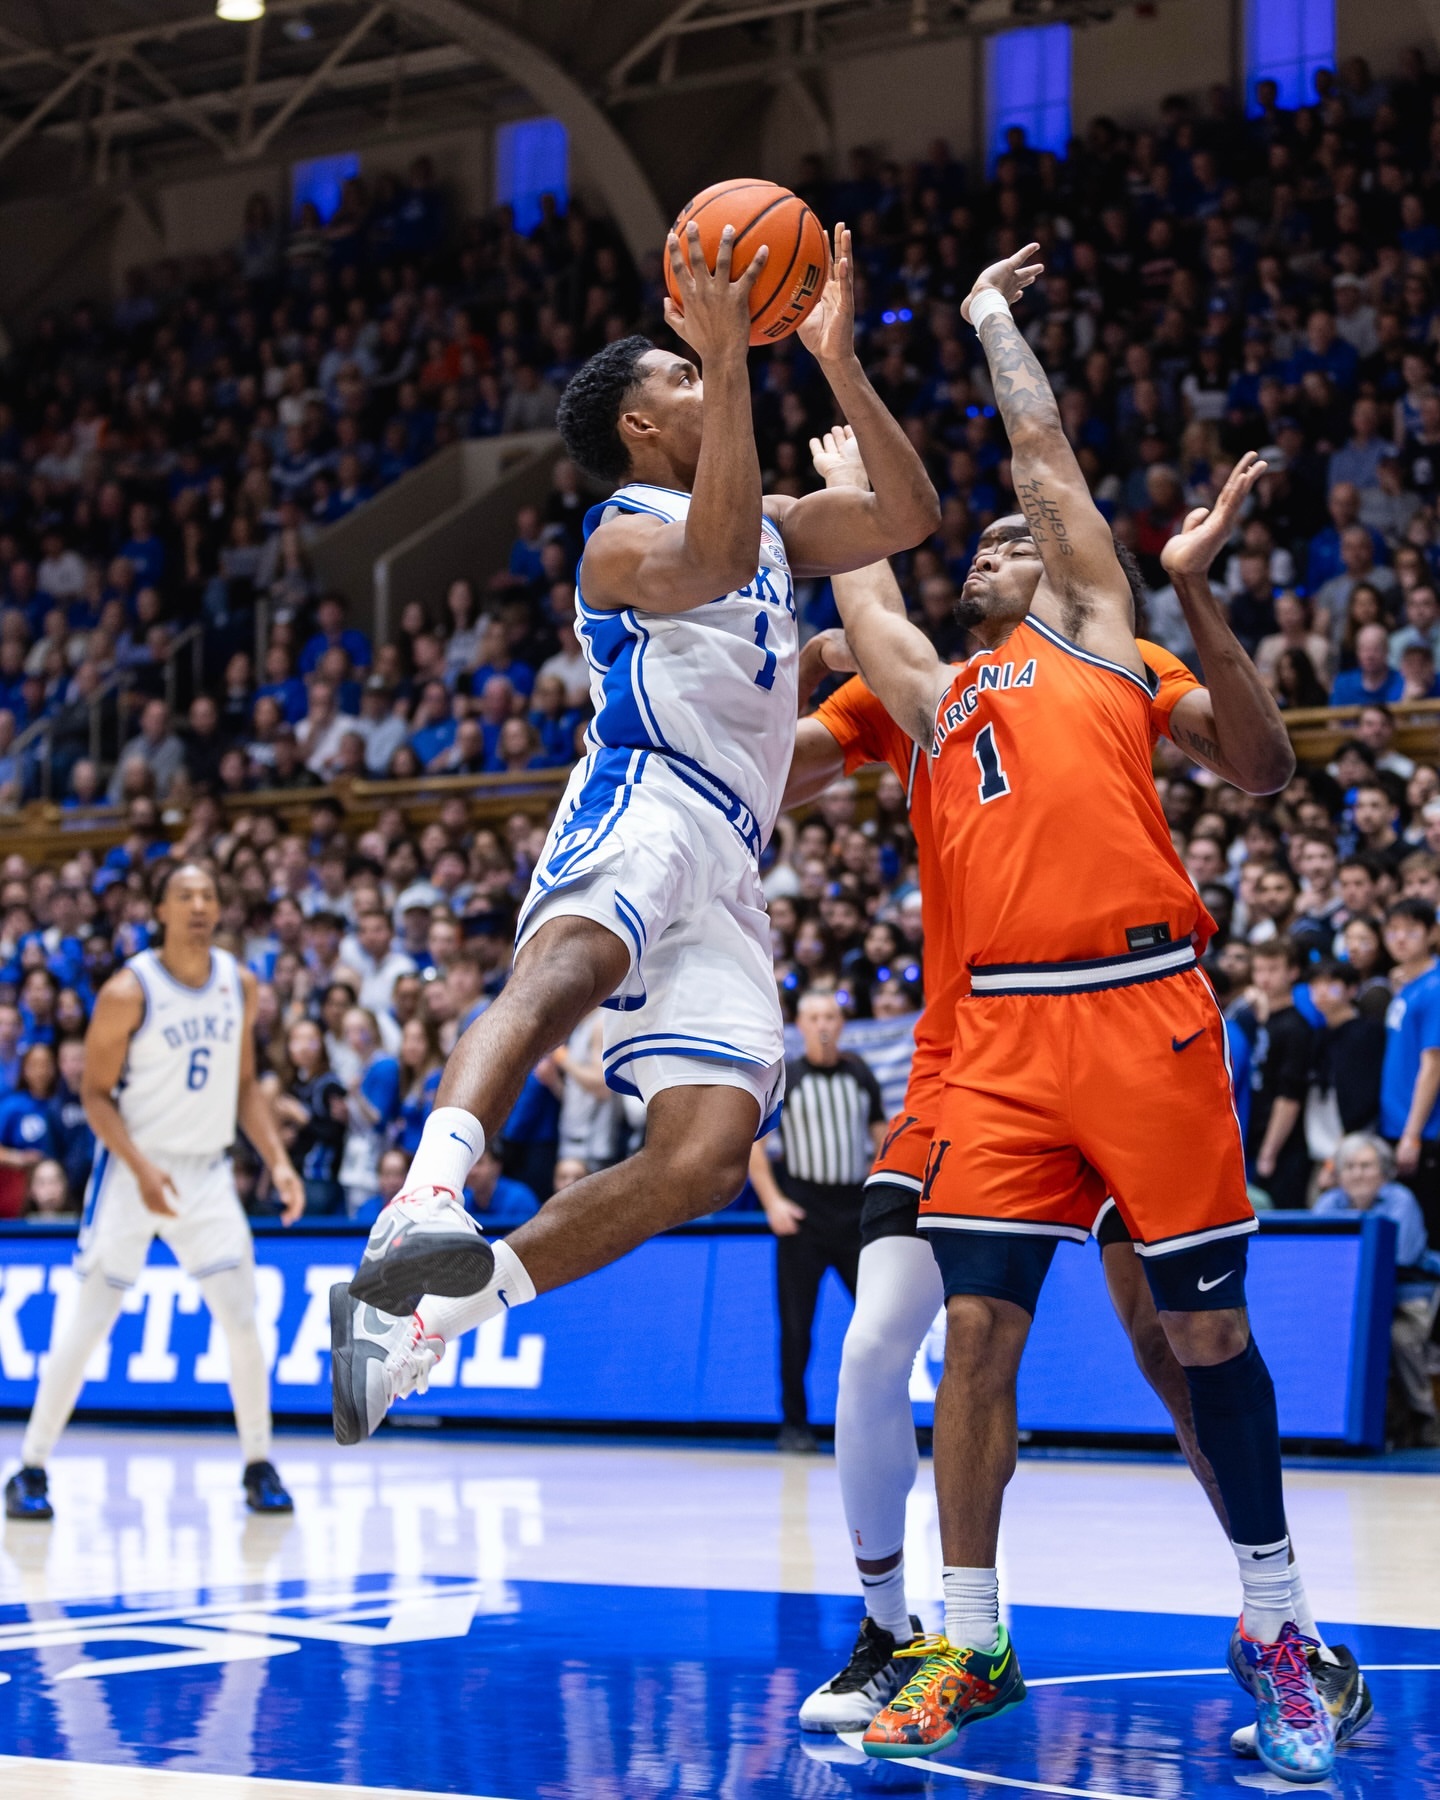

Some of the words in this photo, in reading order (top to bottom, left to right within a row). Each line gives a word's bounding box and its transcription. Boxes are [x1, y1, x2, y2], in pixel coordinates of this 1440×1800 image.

[763, 264, 820, 337] ELITE
[1041, 496, 1074, 556] SIGHT
[754, 611, 777, 690] 1
[972, 721, 1011, 805] 1
[187, 1047, 211, 1091] 6
